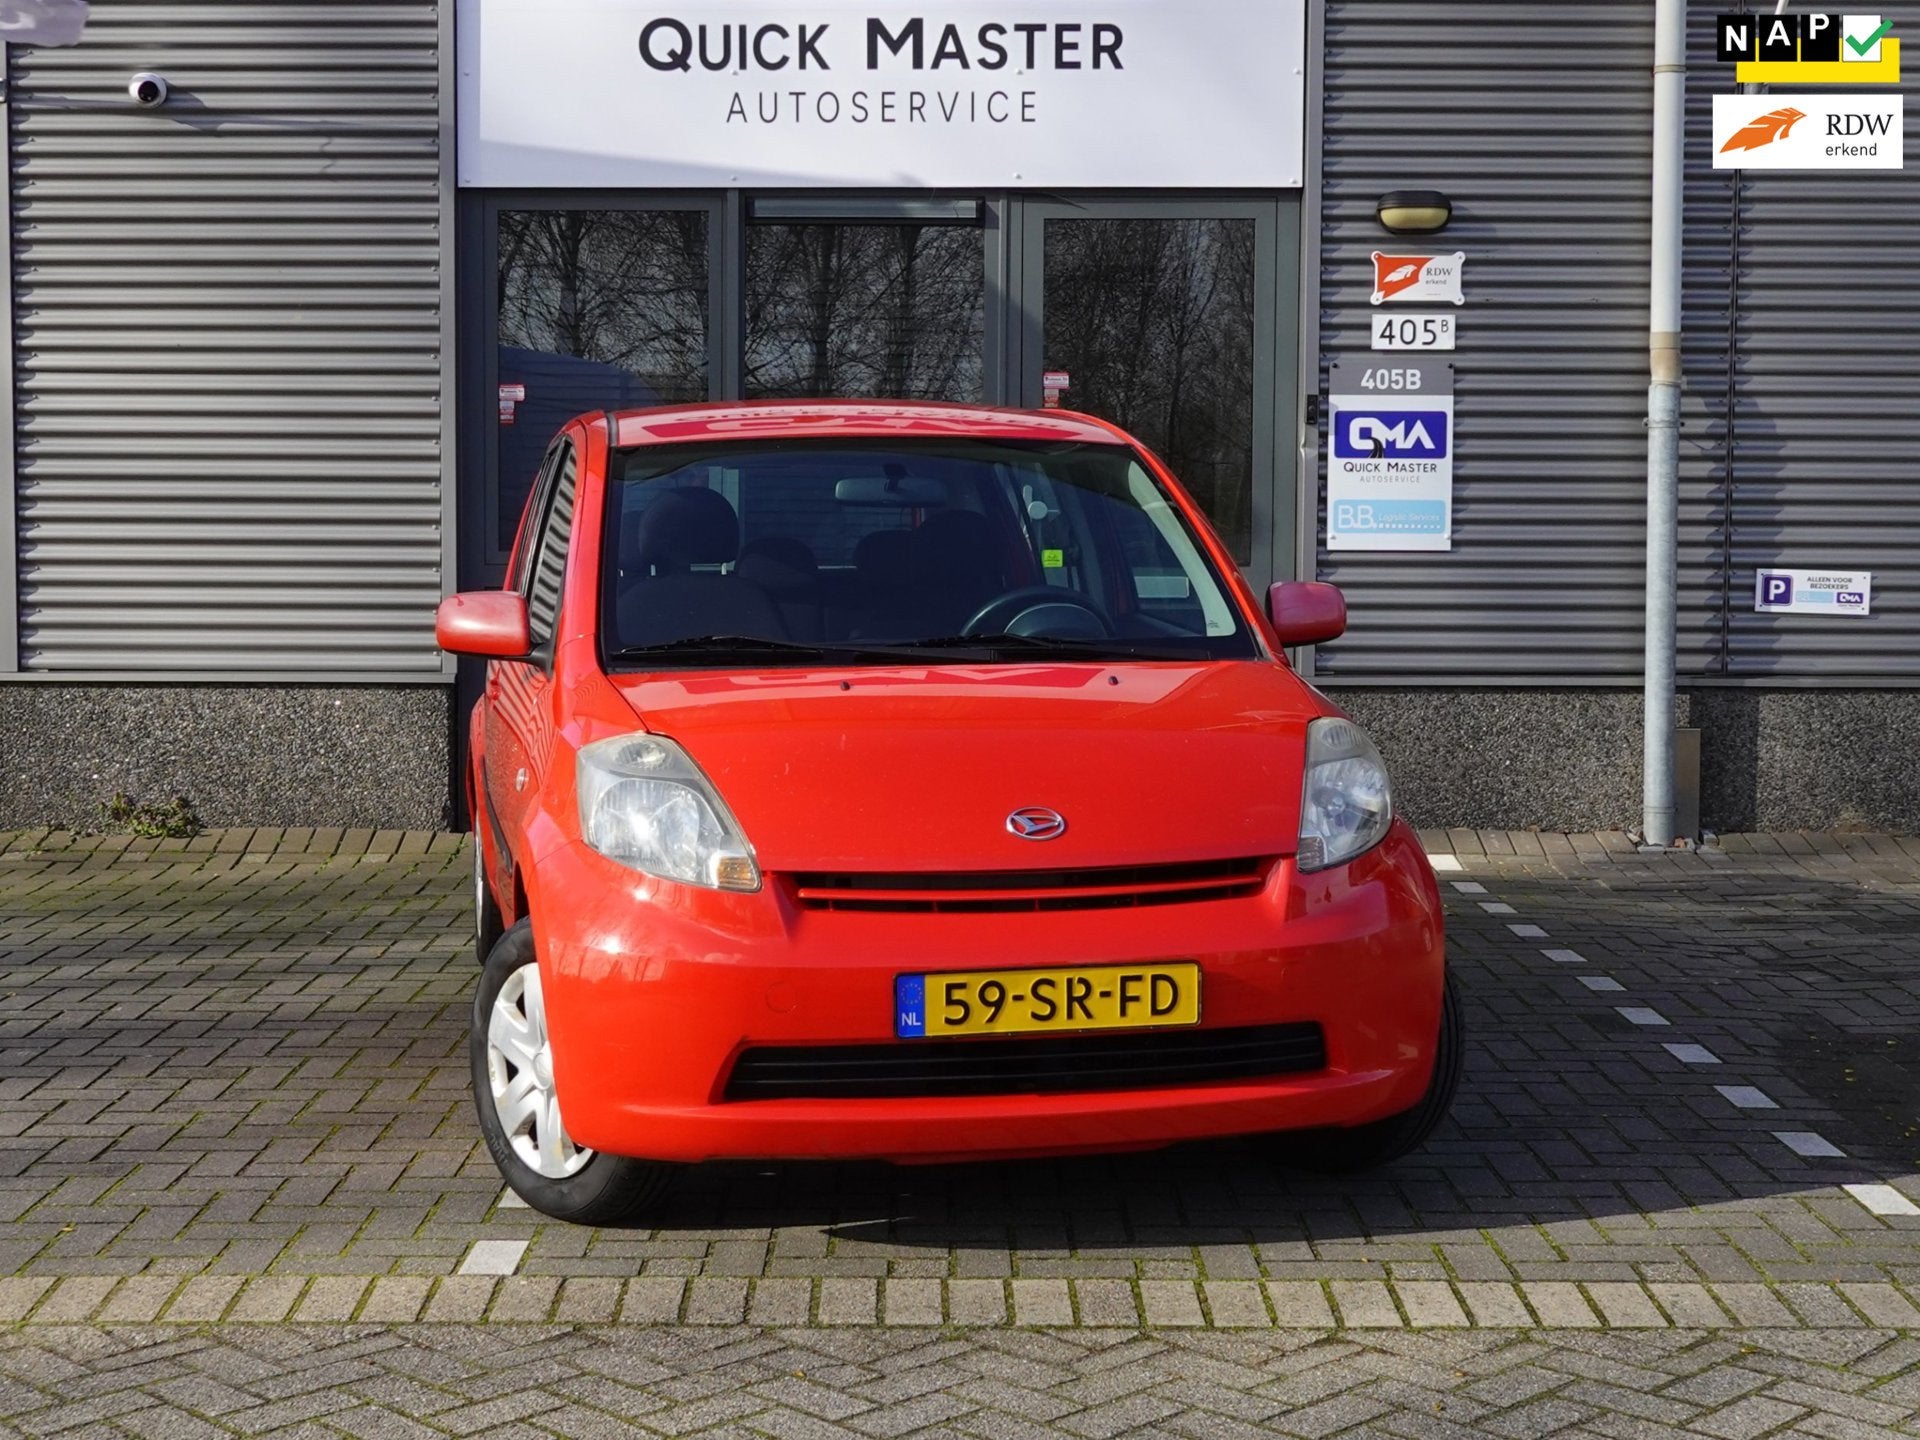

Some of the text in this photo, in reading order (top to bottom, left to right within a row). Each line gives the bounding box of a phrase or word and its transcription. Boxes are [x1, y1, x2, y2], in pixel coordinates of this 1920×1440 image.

[726, 91, 1037, 123] AUTOSERVICE
[1426, 267, 1453, 276] RDW
[1360, 368, 1422, 390] 405B
[1360, 475, 1420, 483] AUTOSERVICE
[1768, 580, 1786, 601] P
[943, 973, 1179, 1026] 59-SR-FD
[901, 1012, 921, 1026] NL
